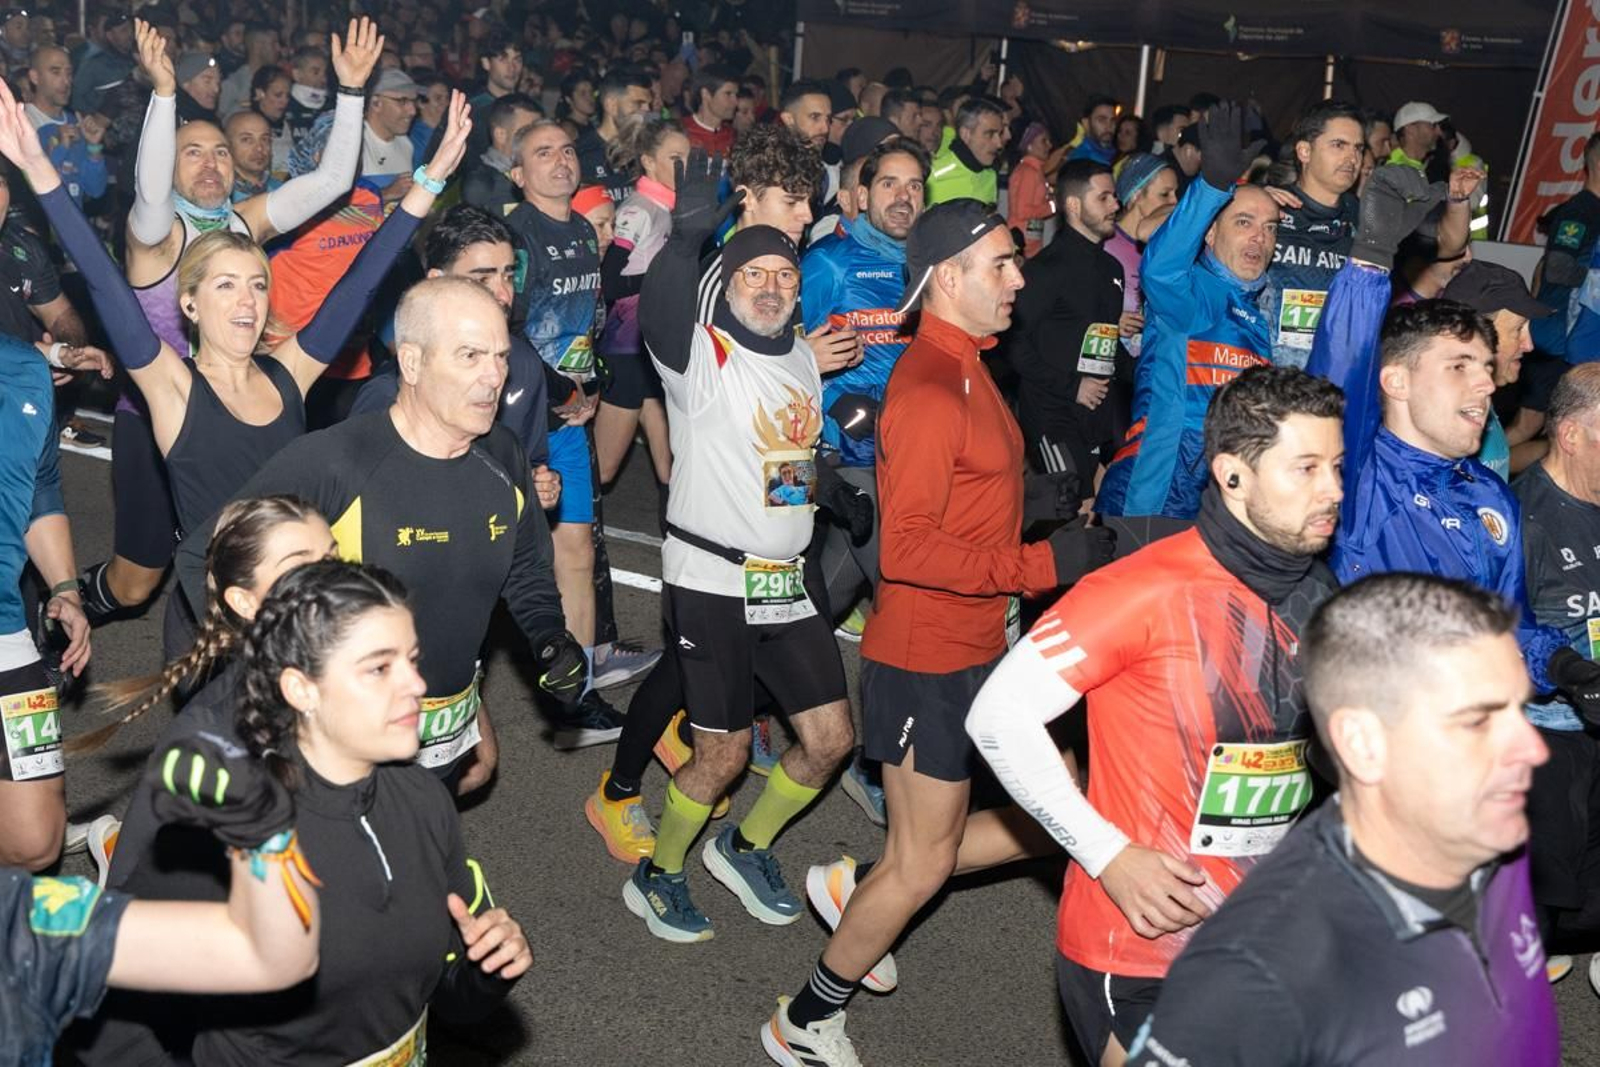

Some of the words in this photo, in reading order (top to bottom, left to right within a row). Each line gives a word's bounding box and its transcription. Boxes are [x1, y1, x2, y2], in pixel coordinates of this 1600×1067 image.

[1272, 243, 1312, 267] SAN
[1316, 251, 1348, 270] ANT
[577, 270, 602, 291] ANT
[856, 270, 895, 279] enerplus
[1288, 306, 1321, 329] 17
[27, 694, 46, 710] 42
[1241, 750, 1265, 769] 42
[1216, 771, 1307, 815] 1777
[647, 890, 668, 917] HOKA
